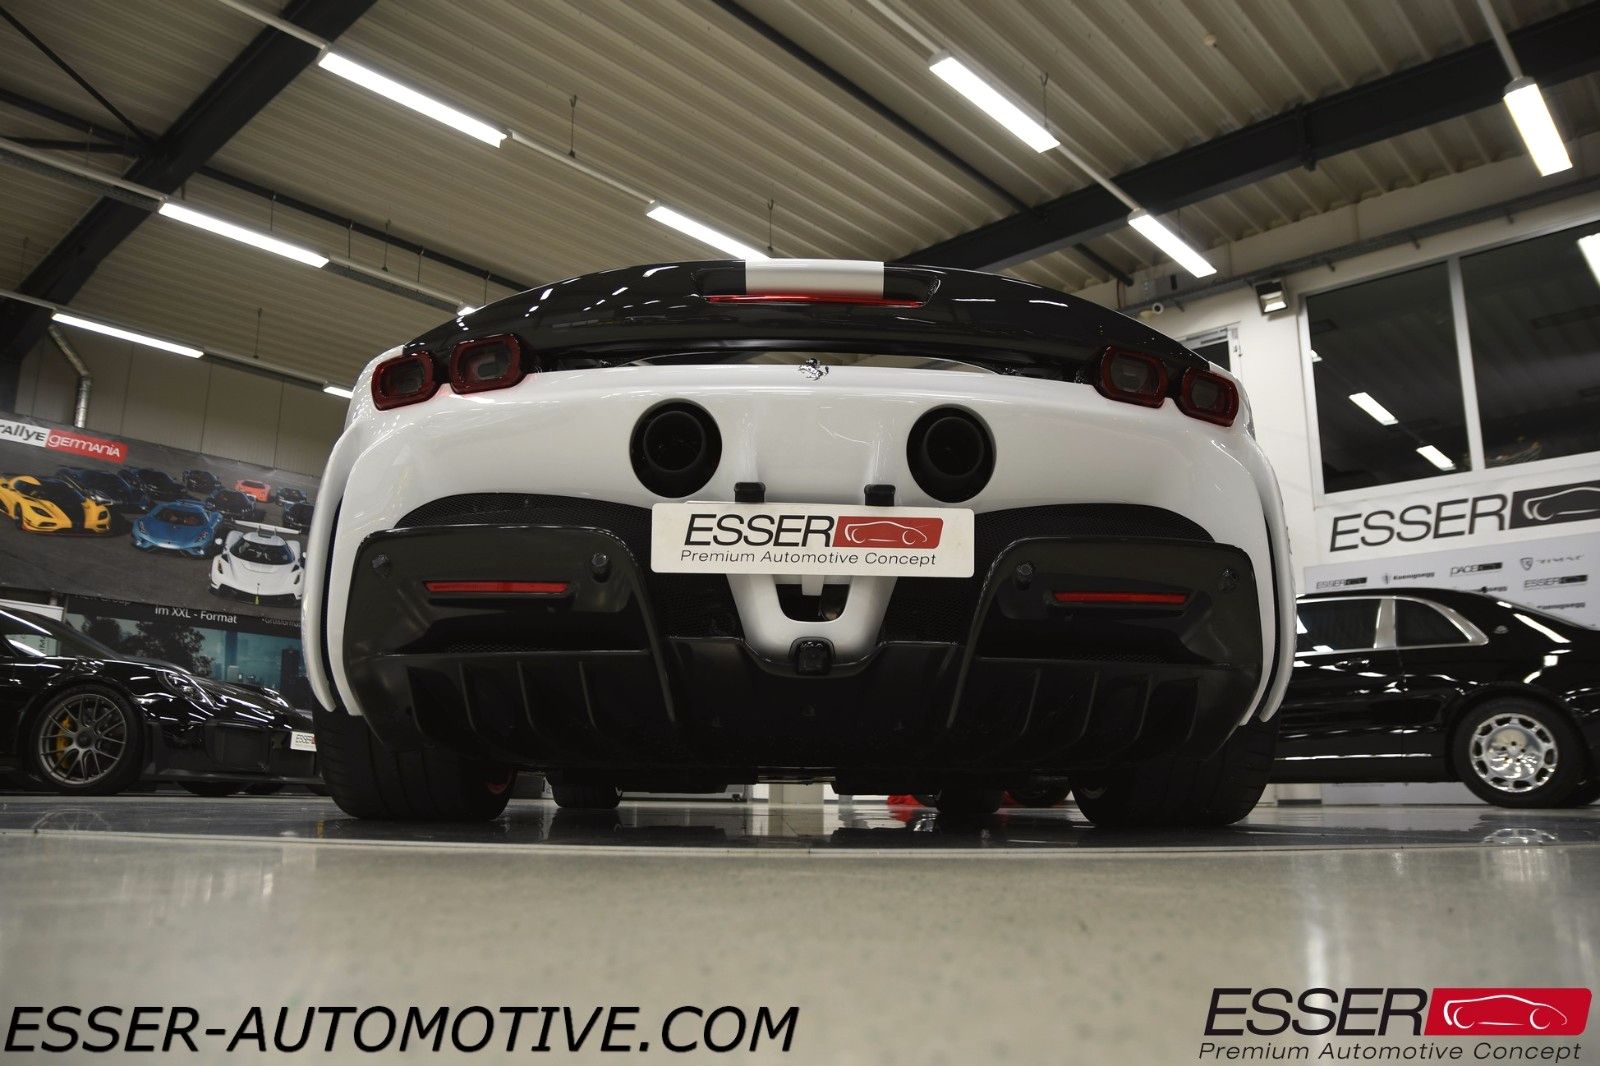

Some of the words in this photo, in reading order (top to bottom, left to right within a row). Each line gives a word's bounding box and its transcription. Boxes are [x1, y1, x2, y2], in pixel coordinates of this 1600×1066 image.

[684, 513, 835, 547] ESSER
[1329, 493, 1508, 552] ESSER
[680, 549, 755, 562] Premium
[760, 550, 859, 564] Automotive
[864, 552, 936, 566] Concept
[171, 607, 191, 618] XXL
[201, 610, 237, 624] Format
